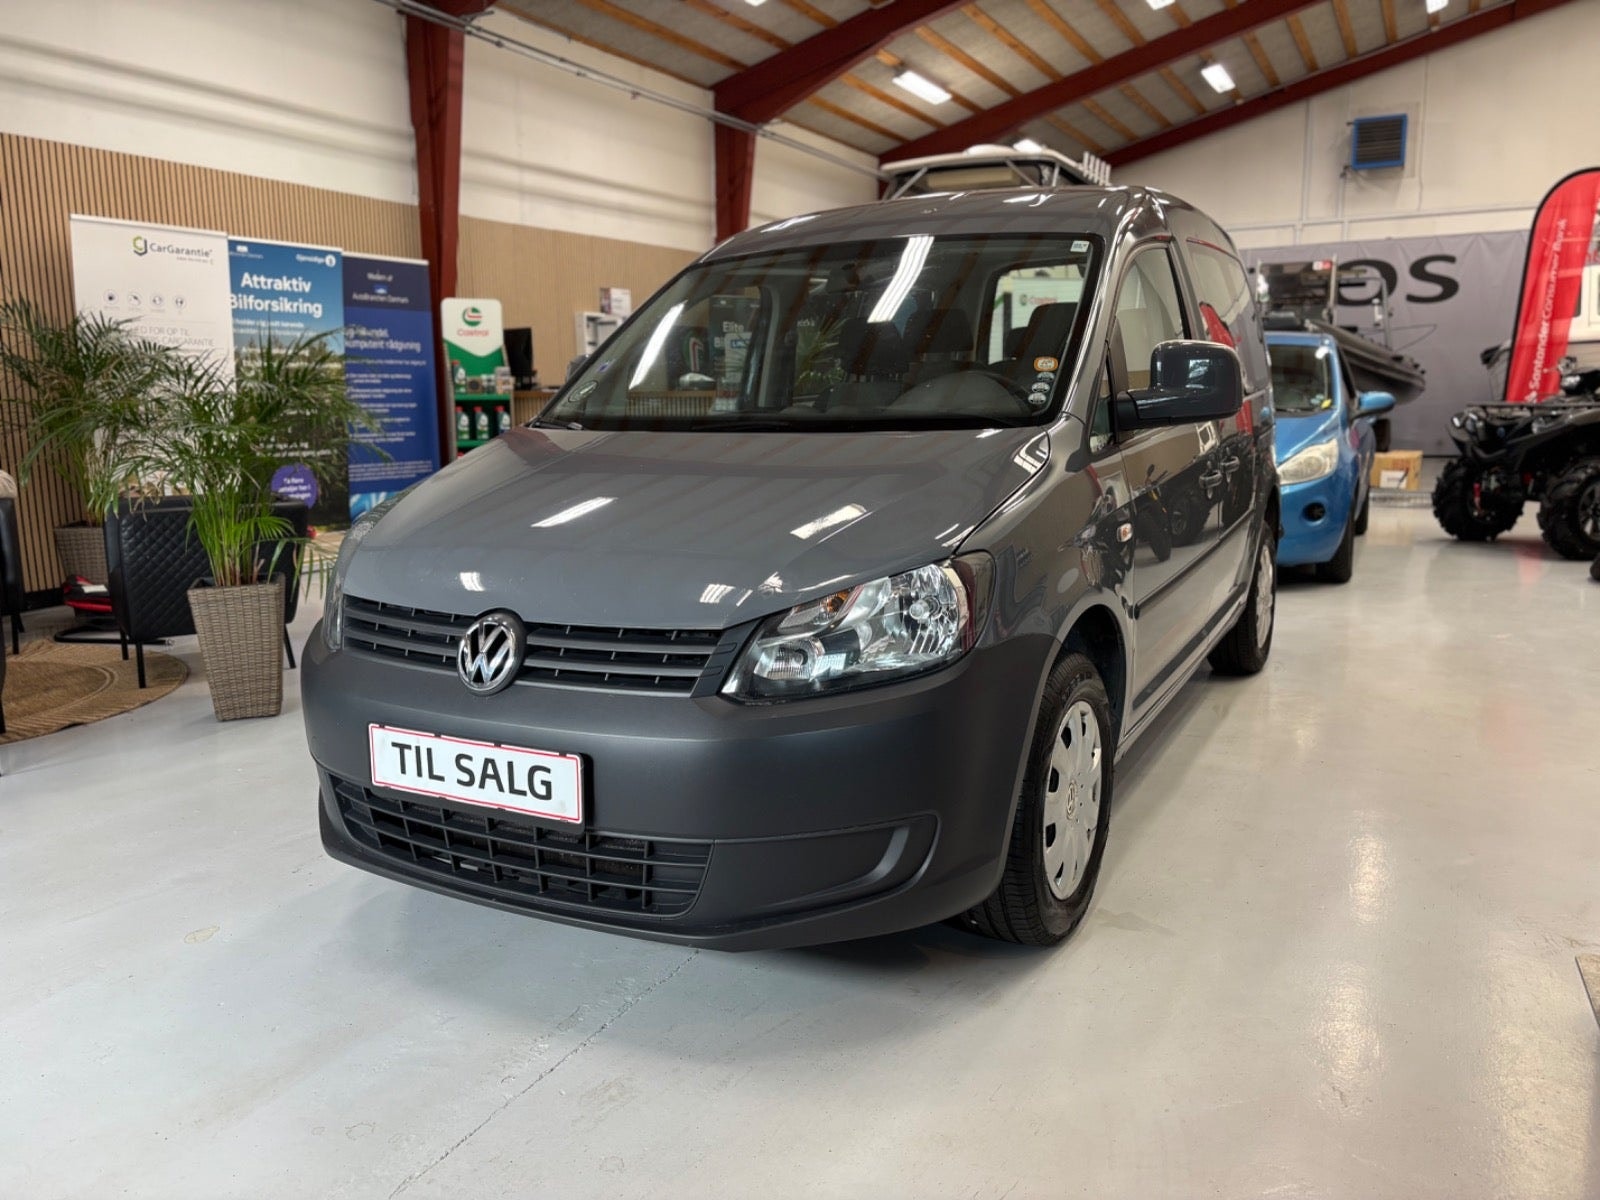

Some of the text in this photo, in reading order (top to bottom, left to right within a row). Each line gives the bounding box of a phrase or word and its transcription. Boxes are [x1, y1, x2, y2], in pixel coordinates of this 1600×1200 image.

[149, 242, 212, 258] CarGarantie
[240, 272, 312, 293] Attraktiv
[230, 293, 323, 319] Bilforsikring
[456, 328, 489, 337] Castrol
[1529, 320, 1549, 390] Santander
[391, 741, 553, 801] TIL SALG
